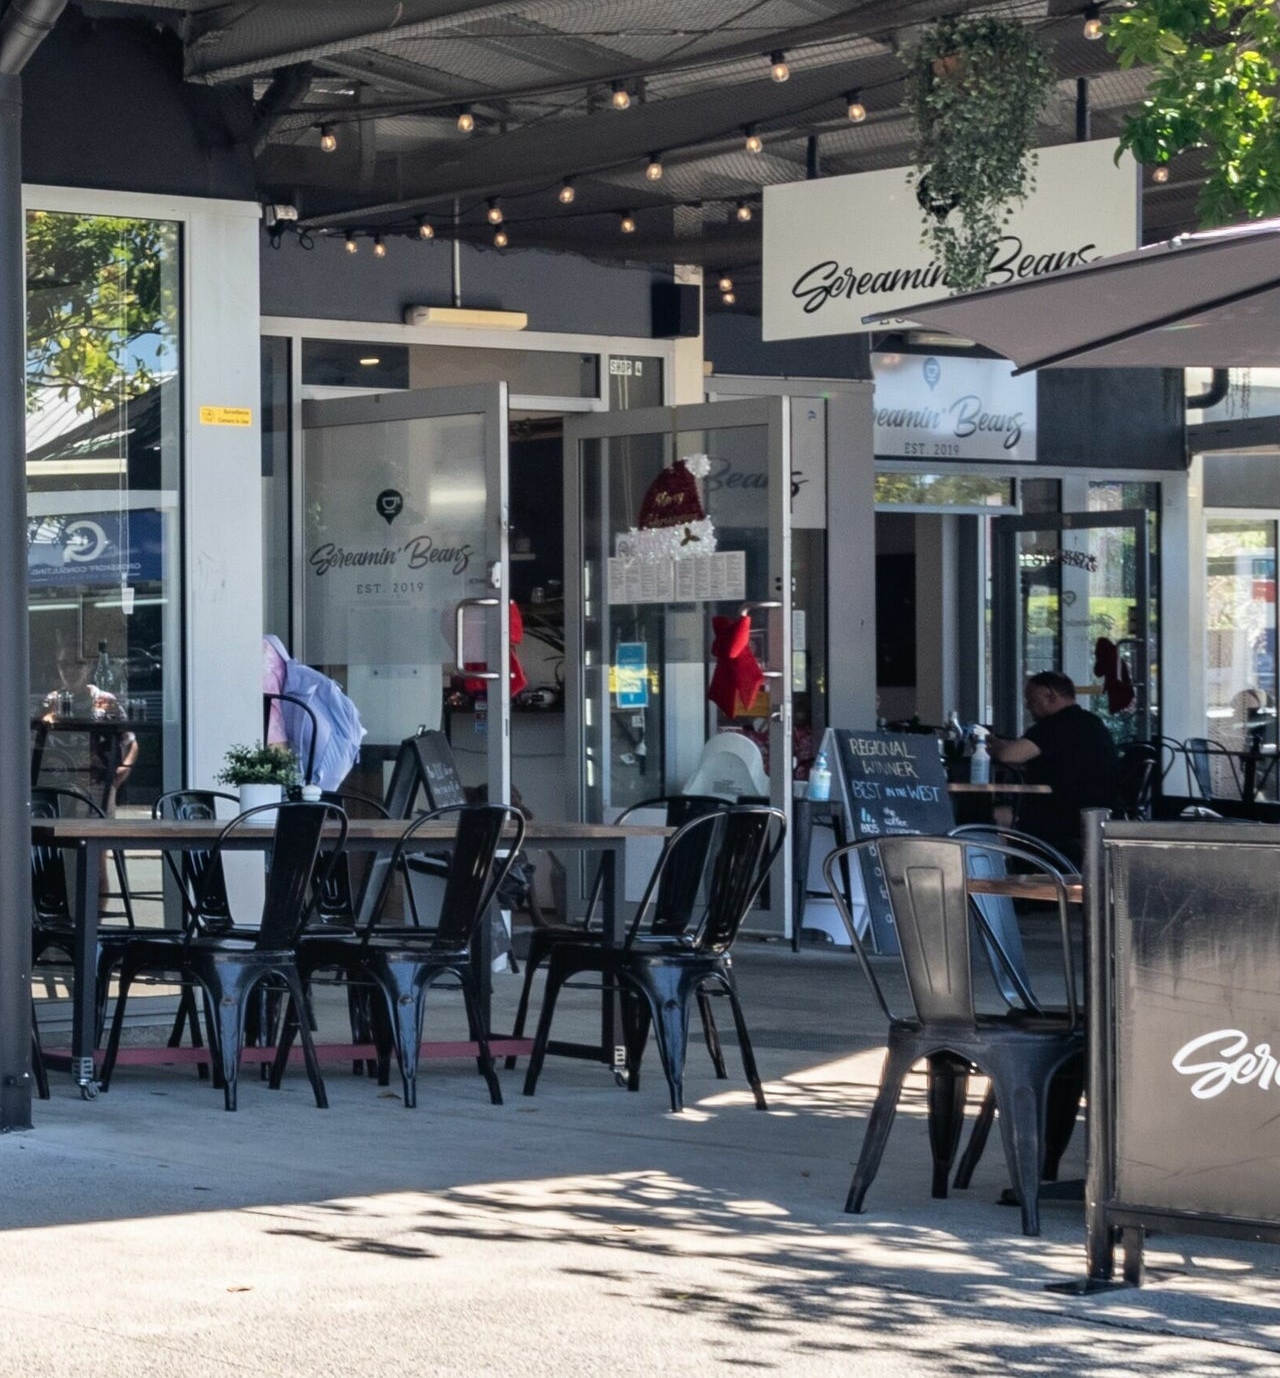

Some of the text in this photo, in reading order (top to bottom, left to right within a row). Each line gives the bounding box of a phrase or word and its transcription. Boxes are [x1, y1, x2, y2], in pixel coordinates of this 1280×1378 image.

[610, 360, 631, 374] SHOP
[949, 395, 1023, 450] Beans
[933, 443, 960, 456] 2019
[404, 535, 474, 575] Beans
[356, 582, 424, 595] EST. 2019
[849, 737, 917, 759] REGIONAL
[862, 760, 920, 779] WINNER
[852, 779, 882, 799] BEST
[907, 784, 940, 802] WEST
